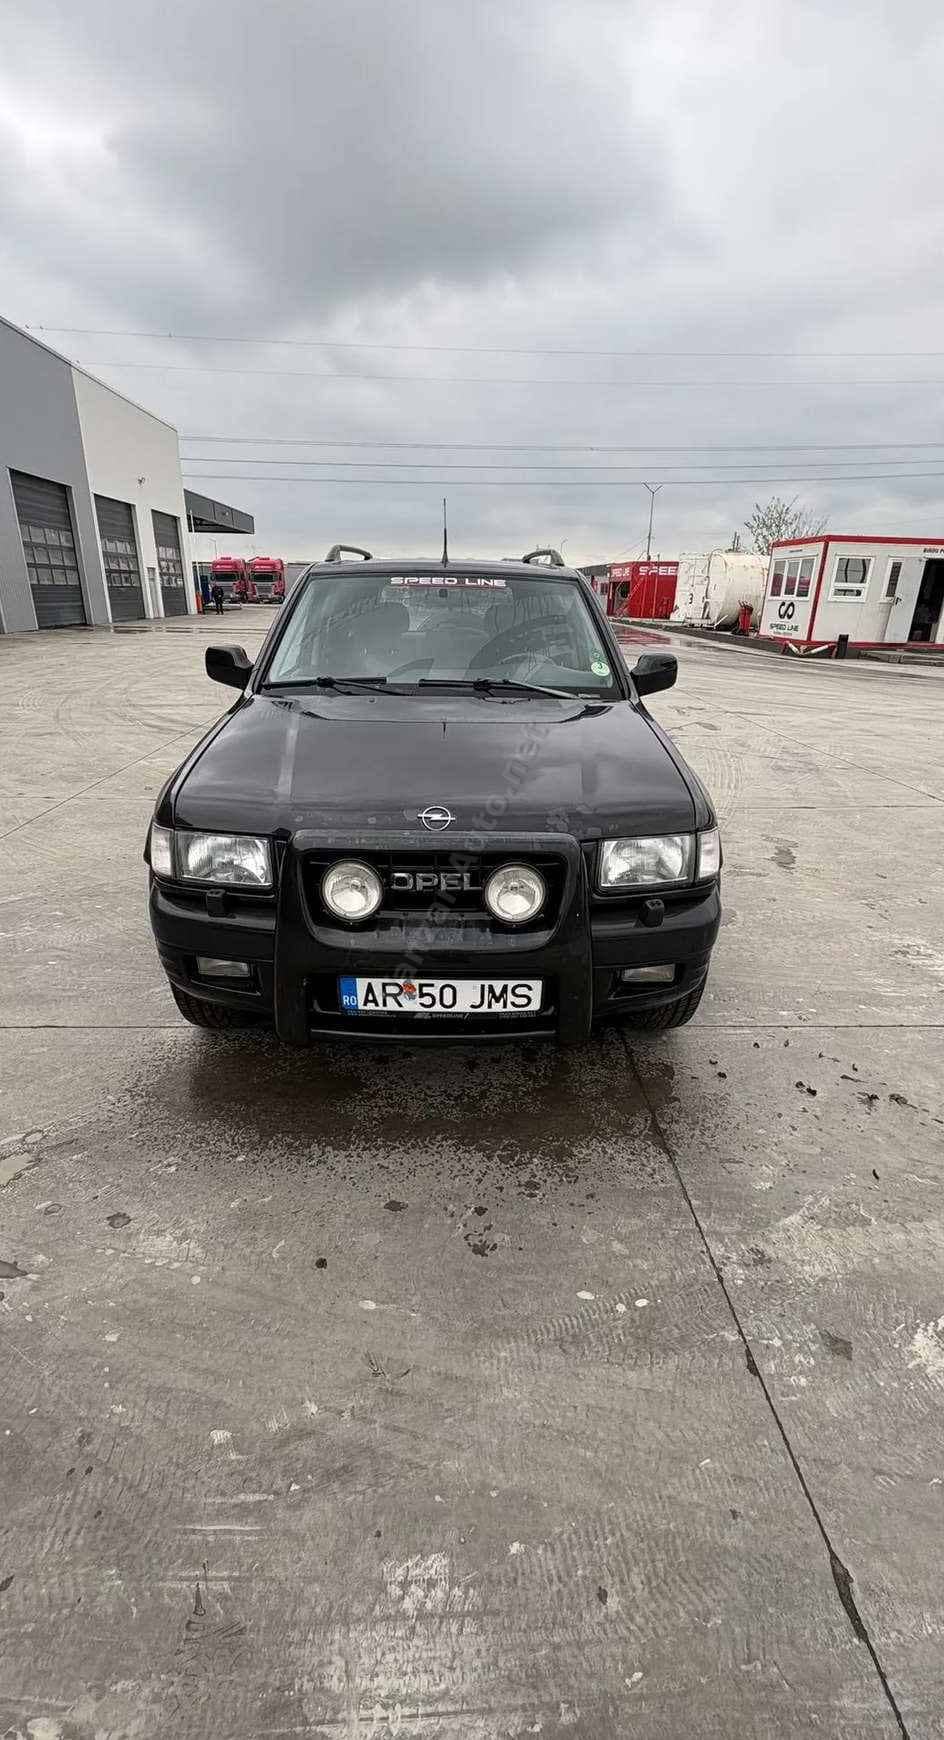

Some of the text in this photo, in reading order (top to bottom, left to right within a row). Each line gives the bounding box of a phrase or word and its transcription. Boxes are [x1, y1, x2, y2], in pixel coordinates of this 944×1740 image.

[390, 576, 507, 588] SPEED LINE
[391, 872, 482, 891] OPEL
[343, 995, 358, 1006] RO
[362, 981, 533, 1010] AR 50 JMS
